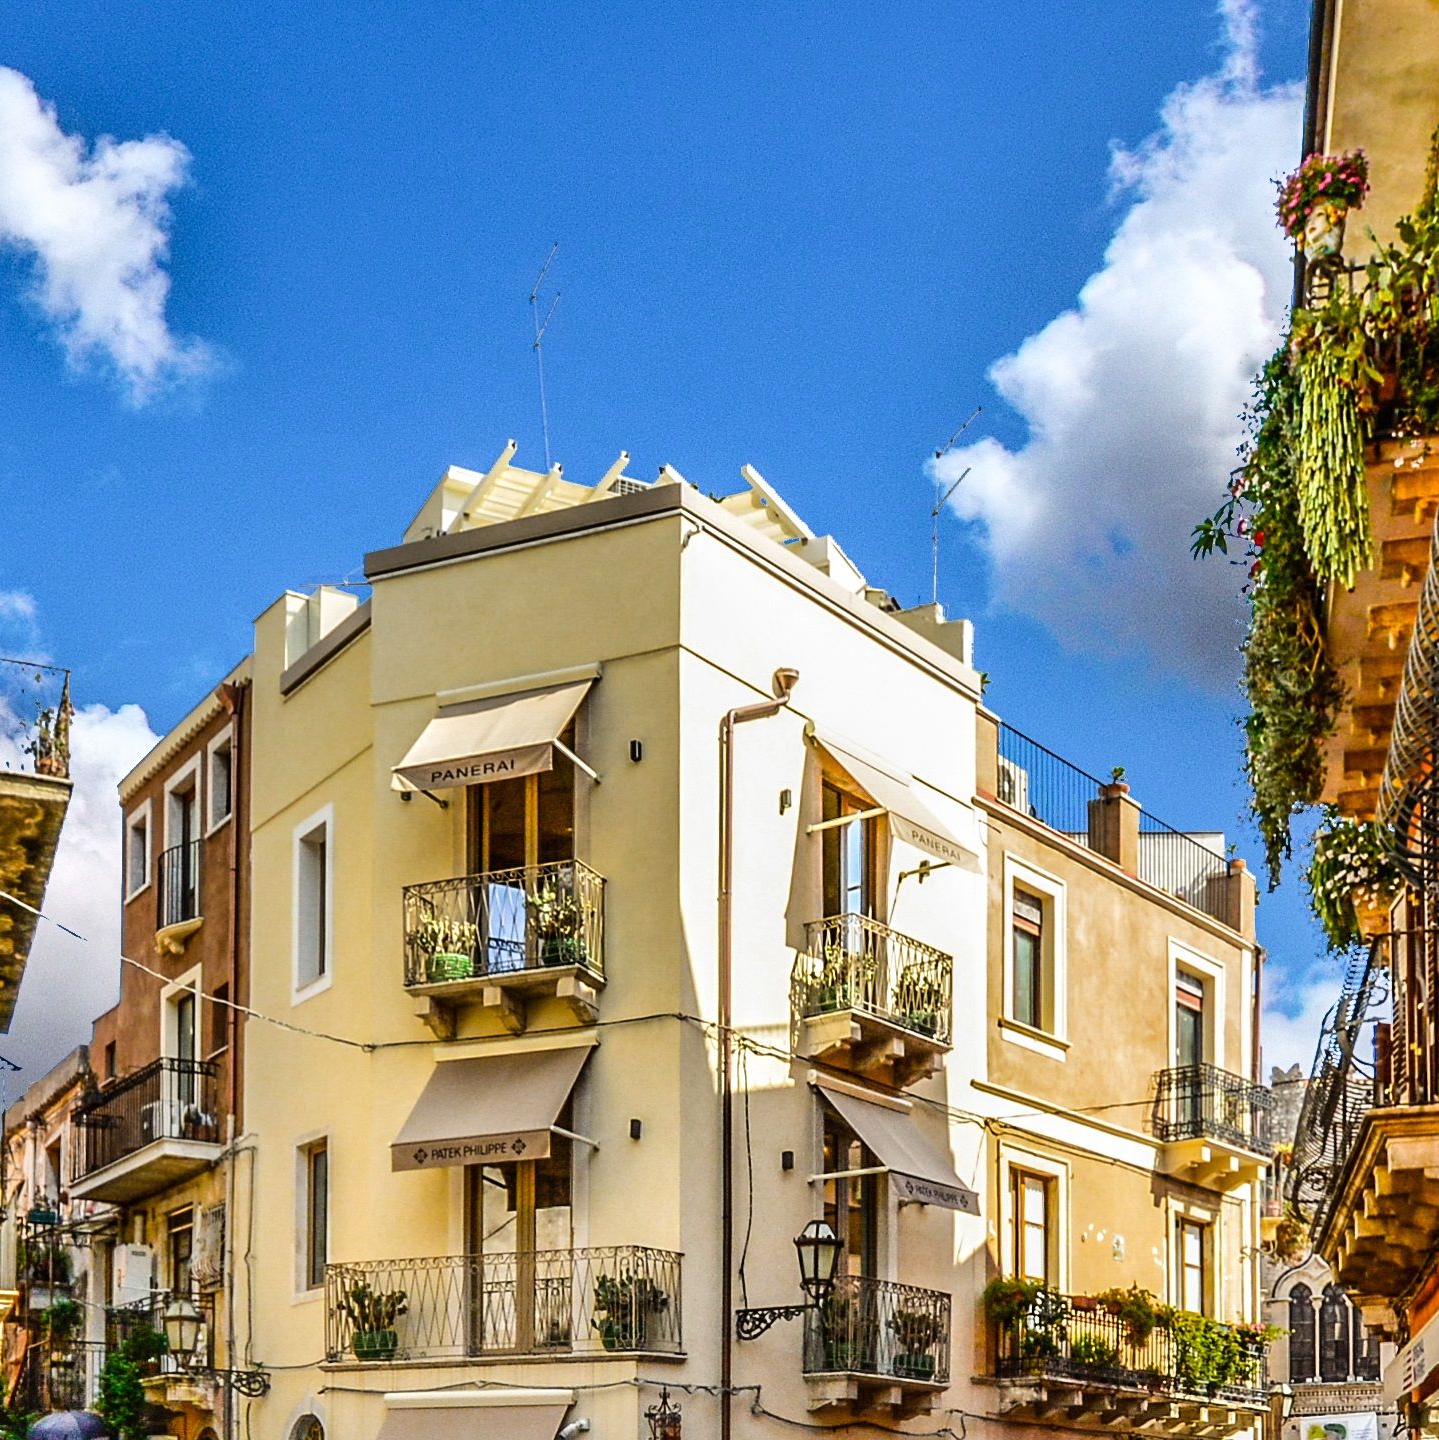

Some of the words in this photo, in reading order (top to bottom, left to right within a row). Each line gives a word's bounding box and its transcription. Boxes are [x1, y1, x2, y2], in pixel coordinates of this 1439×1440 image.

[431, 759, 515, 783] PANERAI
[911, 830, 961, 861] PANERAI
[431, 1146, 462, 1160] PATEK
[463, 1142, 508, 1158] PHILIPPE
